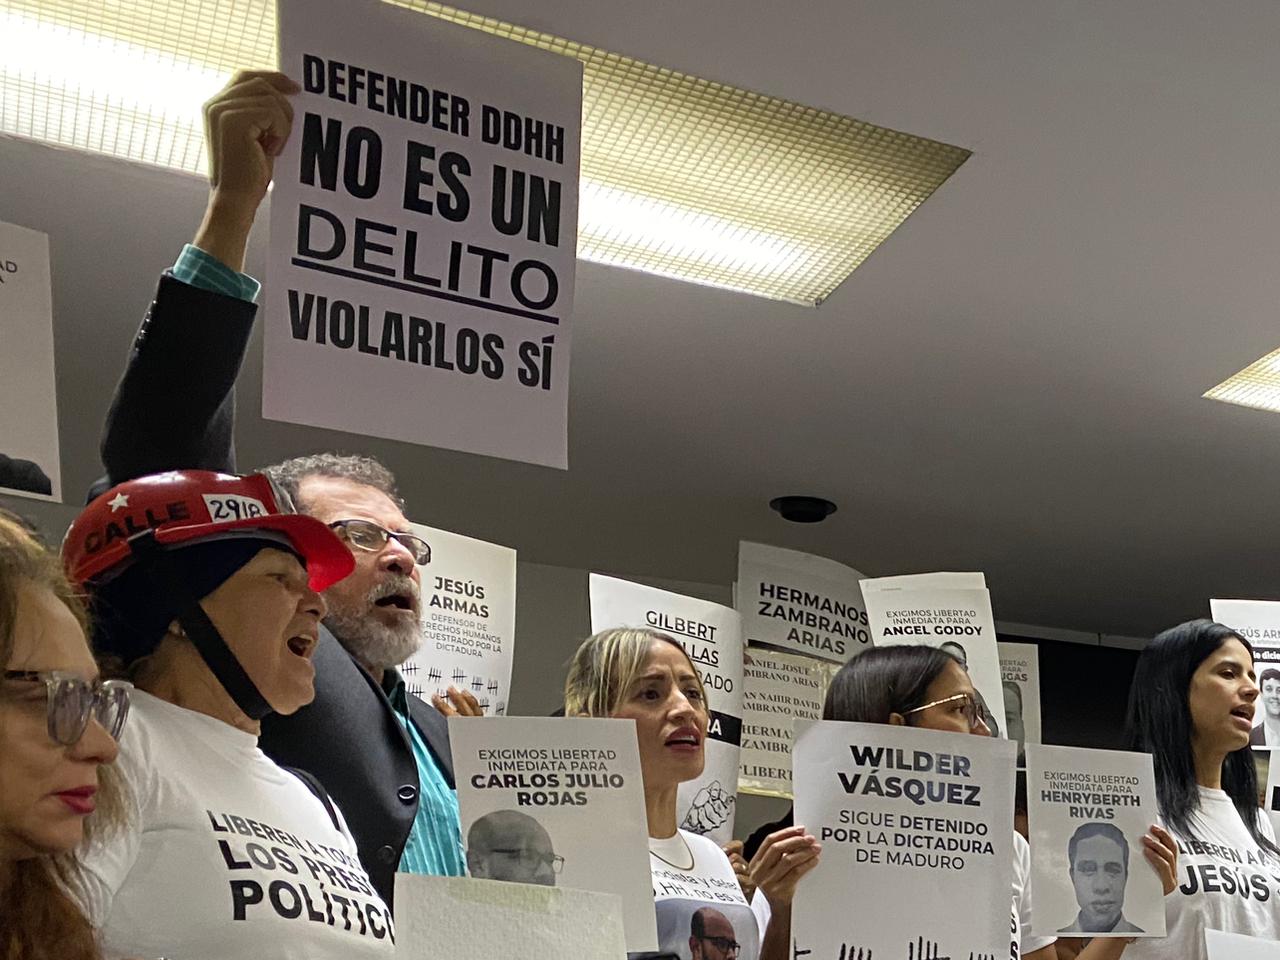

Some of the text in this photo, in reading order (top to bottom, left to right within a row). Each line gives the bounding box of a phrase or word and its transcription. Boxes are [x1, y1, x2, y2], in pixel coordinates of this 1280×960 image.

[302, 54, 564, 164] DEFENDER DDHH
[298, 207, 559, 311] DELITO
[288, 290, 554, 390] VIOLARLOS SÍ
[85, 502, 191, 553] CALLE
[435, 576, 484, 599] JESÚS
[430, 594, 489, 618] ARMAS
[760, 582, 868, 626] HERMANOS
[432, 613, 487, 631] DEFENSOR DE
[646, 611, 717, 640] GILBERT
[758, 602, 868, 644] ZAMBRANO
[883, 626, 982, 636] ANGEL GODOY
[787, 628, 845, 655] ARIAS
[781, 663, 810, 676] JOSUE
[479, 750, 616, 760] EXIGIMOS LIBERTAD
[489, 761, 608, 771] INMEDIATA PARA
[850, 745, 971, 777] WILDER
[471, 774, 624, 788] CARLOS JULIO
[838, 769, 980, 806] VÁSQUEZ
[1044, 771, 1139, 785] EXIGIMOS LIBERTAD
[1050, 782, 1132, 793] INMEDIATA PARA
[517, 792, 587, 805] ROJAS
[1041, 790, 1140, 806] HENRYBERTH
[840, 810, 988, 835] SIGUE DETENIDO
[1070, 806, 1114, 819] RIVAS
[207, 810, 306, 852] LIBEREN
[822, 828, 994, 855] POR LA DICTADURA
[218, 840, 298, 874] LOS
[857, 849, 964, 869] DE MADURO
[1176, 840, 1258, 864] LIBEREN A
